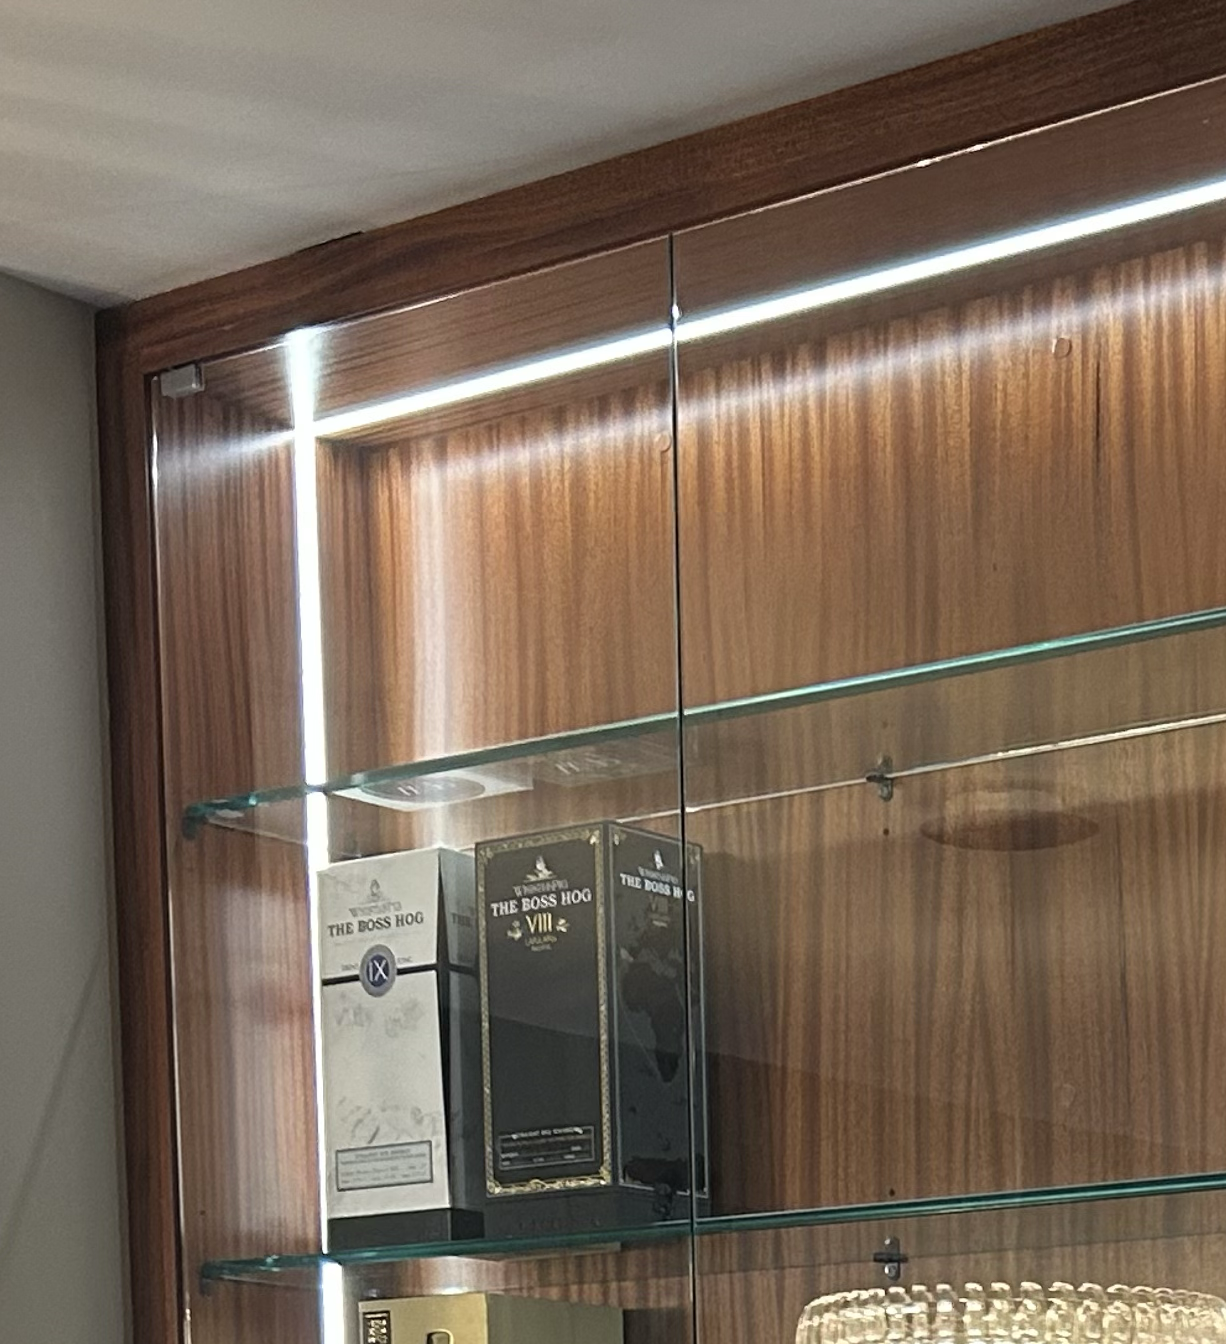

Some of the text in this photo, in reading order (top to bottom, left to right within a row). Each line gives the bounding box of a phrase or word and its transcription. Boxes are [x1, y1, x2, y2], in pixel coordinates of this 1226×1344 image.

[620, 872, 642, 889] THE
[644, 879, 671, 896] BOSS
[673, 886, 696, 902] HG
[491, 888, 592, 917] THE BOSS HOG
[327, 911, 424, 938] THE BOSS HOG
[525, 912, 553, 934] VIII
[368, 959, 388, 982] IX
